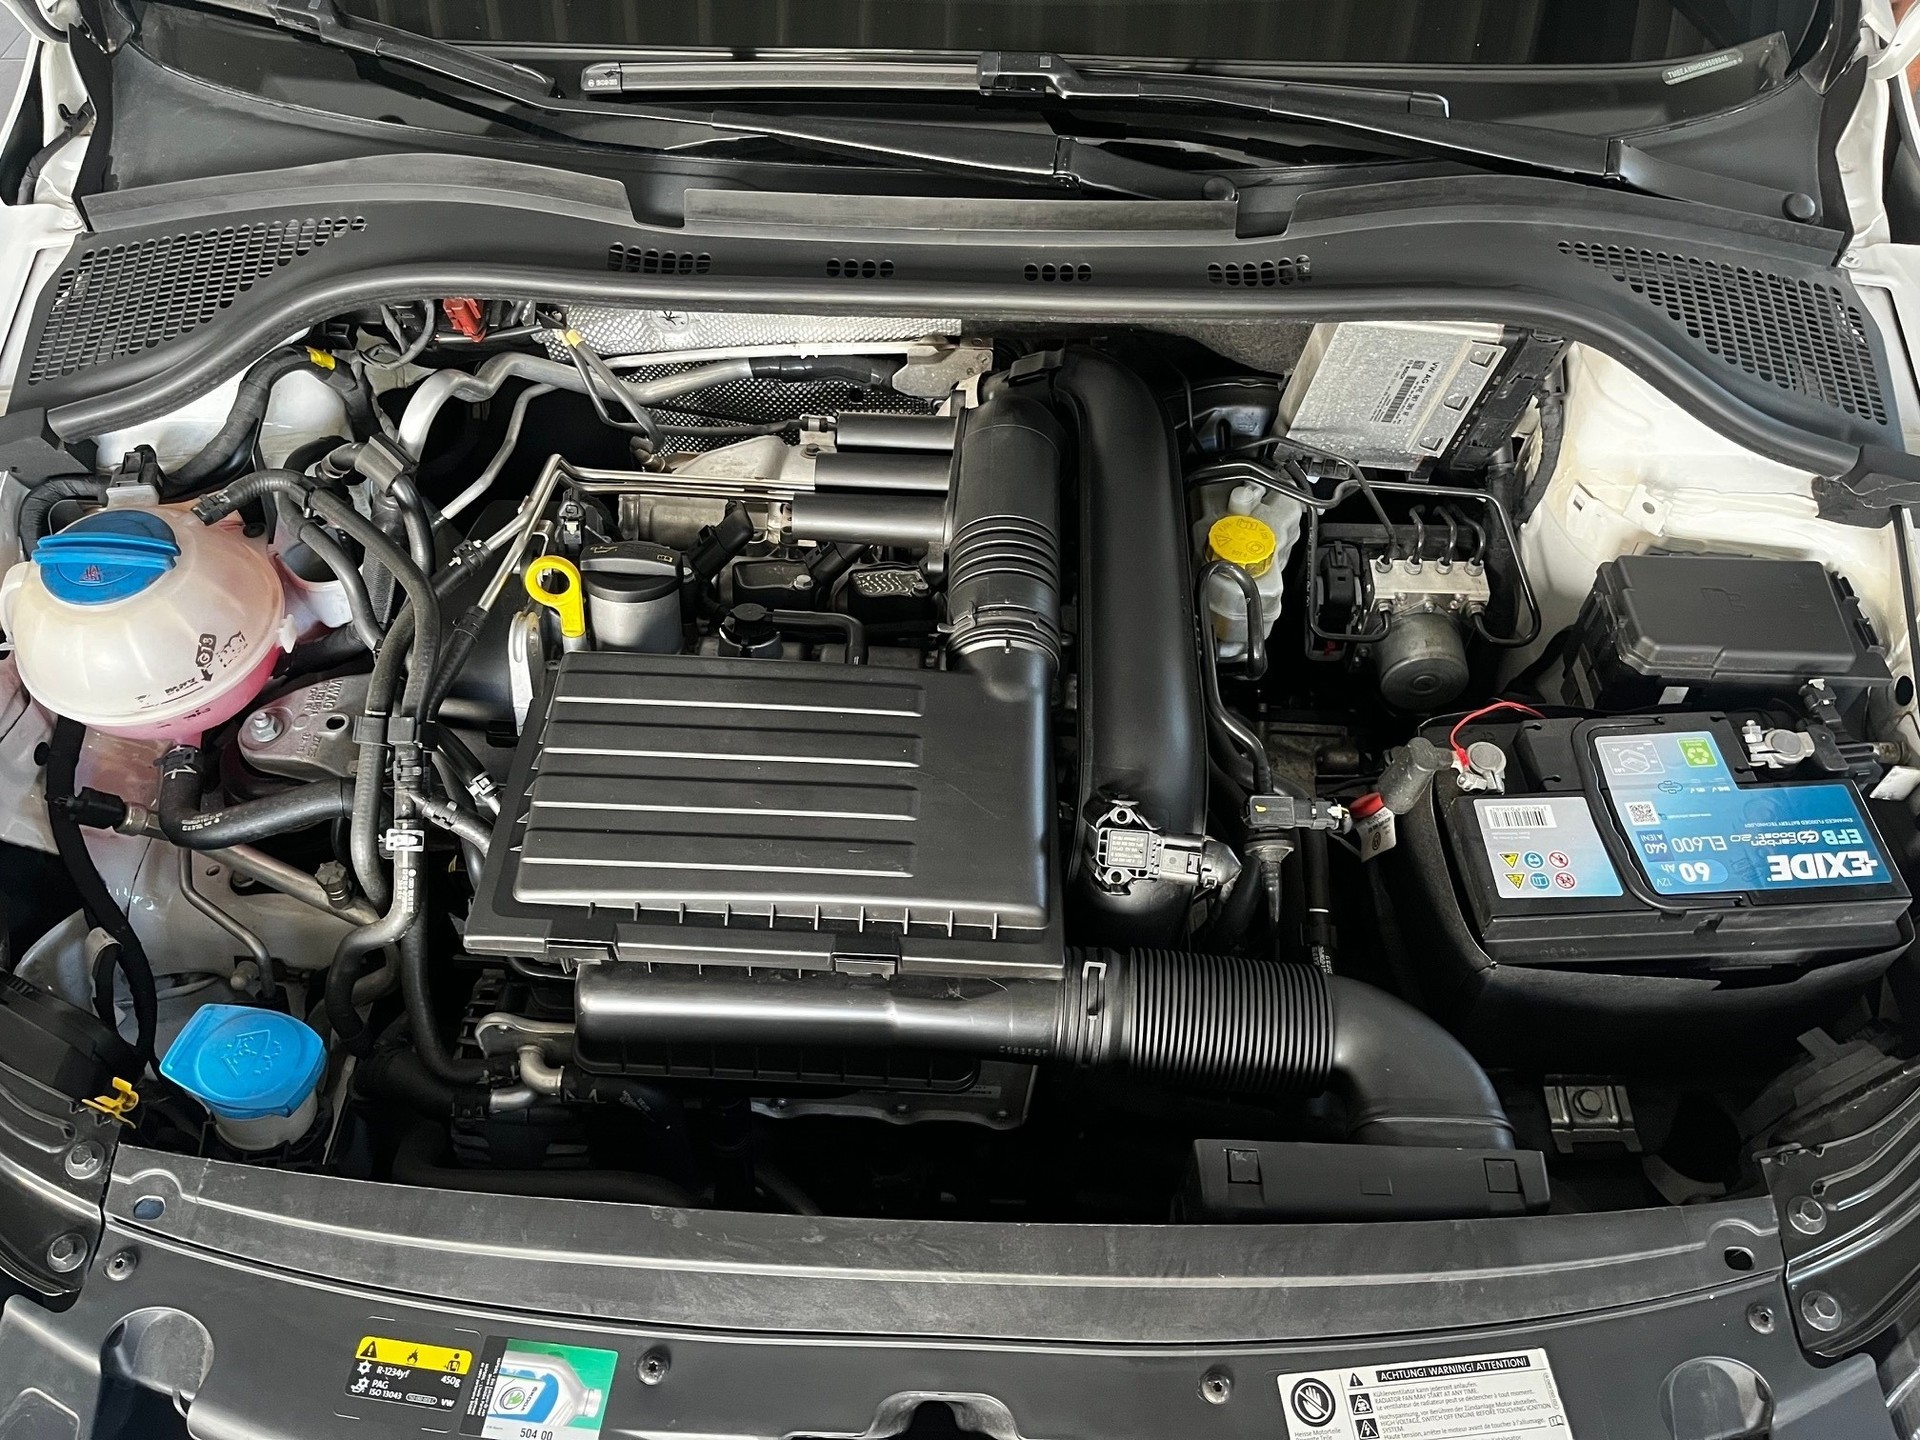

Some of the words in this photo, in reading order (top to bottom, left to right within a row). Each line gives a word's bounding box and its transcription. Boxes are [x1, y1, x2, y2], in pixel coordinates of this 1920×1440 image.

[1428, 362, 1440, 373] VW
[1421, 374, 1431, 384] AG
[1750, 838, 1798, 847] carbon
[1822, 828, 1864, 845] EFB
[1644, 842, 1667, 854] 640
[1671, 836, 1728, 853] EL600
[1661, 864, 1675, 873] Ah
[1678, 862, 1711, 882] 60
[1766, 850, 1878, 882] EXIDE
[1657, 878, 1672, 887] 12V
[1381, 1368, 1427, 1380] ACHTUNG!
[1428, 1362, 1475, 1376] WARNING!
[1476, 1357, 1527, 1371] ATTENTION!
[376, 1366, 410, 1379] R-1234yf
[440, 1375, 461, 1388] 450g
[372, 1379, 389, 1389] PAG
[369, 1388, 382, 1396] ISO
[382, 1390, 402, 1400] 13043
[441, 1399, 455, 1407] VW
[520, 1428, 537, 1438] 504
[541, 1430, 553, 1440] 00
